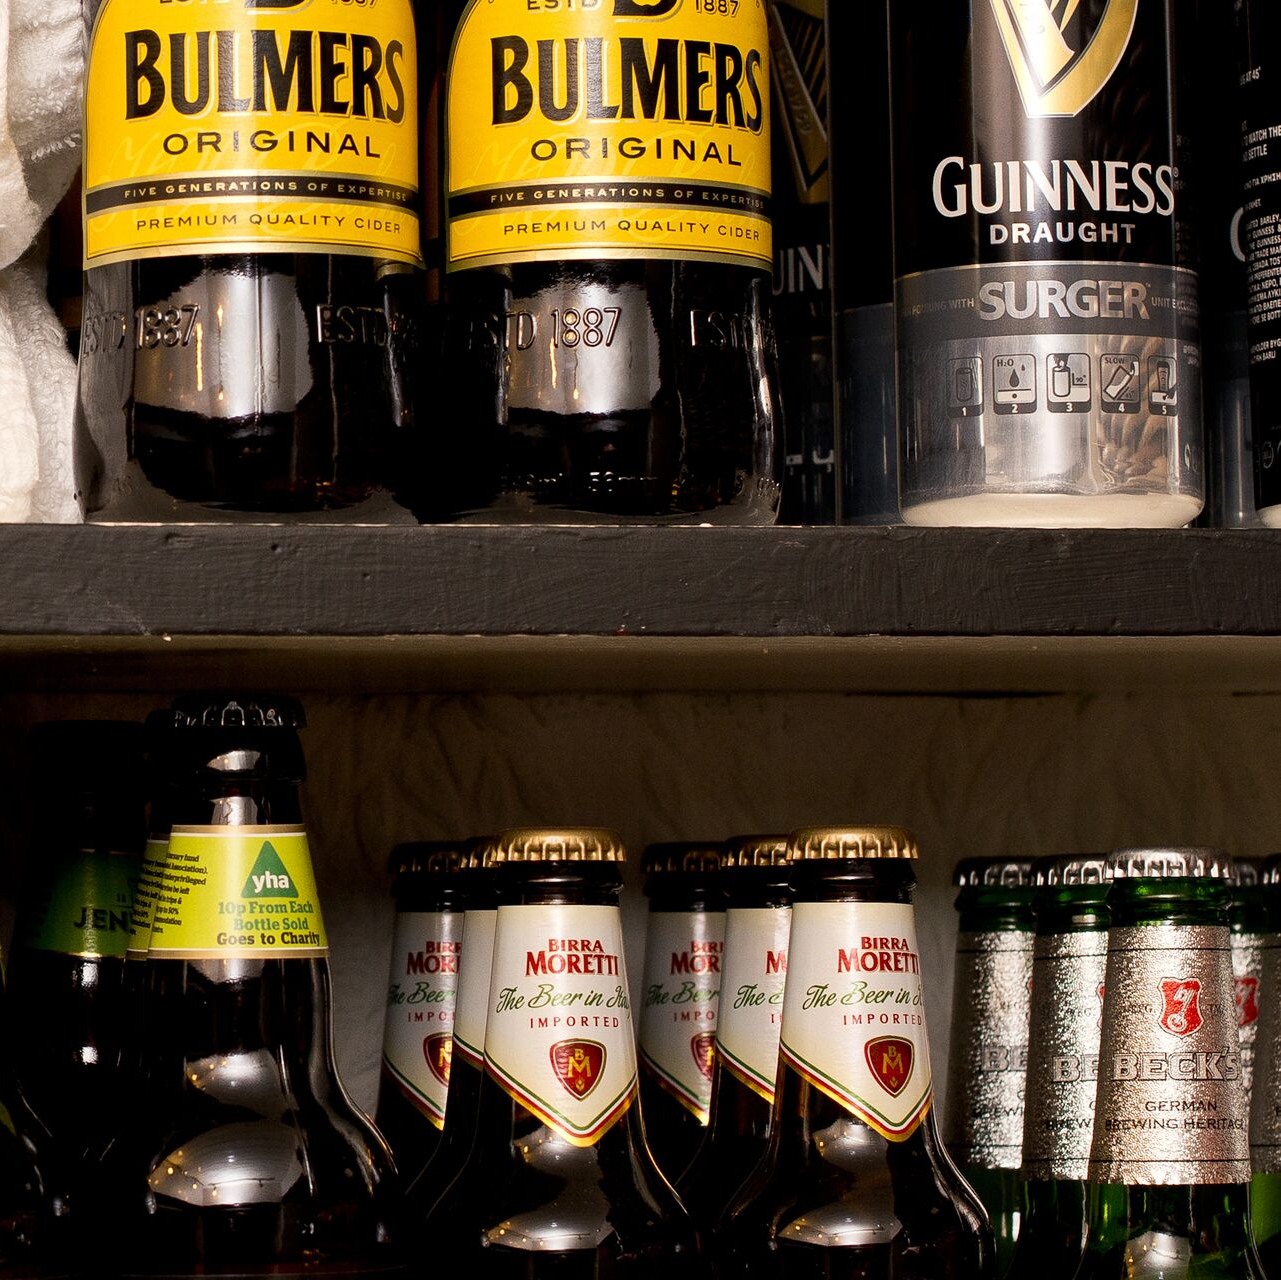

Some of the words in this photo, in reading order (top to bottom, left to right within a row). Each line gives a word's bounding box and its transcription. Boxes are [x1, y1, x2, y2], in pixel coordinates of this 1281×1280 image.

[123, 27, 409, 125] BULMERS
[489, 35, 765, 137] BULMERS
[162, 130, 383, 160] ORIGINAL
[530, 136, 743, 168] ORIGINAL
[124, 186, 158, 200] FIVE
[165, 180, 298, 196] GENERATIONS
[307, 181, 330, 193] OF
[337, 184, 409, 203] EXPERTISE
[932, 155, 1175, 218] GUINNESS
[136, 213, 239, 232] PREMIUM
[249, 214, 346, 229] QUALITY
[353, 216, 403, 236] CIDER
[988, 222, 1137, 246] DRAUGHT
[979, 280, 1149, 321] SURGER
[550, 306, 622, 351] 1887
[548, 937, 605, 953] BIRRA
[860, 935, 909, 952] BIRRA
[525, 949, 620, 977] MORETTI
[530, 1015, 620, 1030] IMPORTED
[1110, 1047, 1243, 1082] BECK'S
[1145, 1100, 1218, 1113] GERMAN
